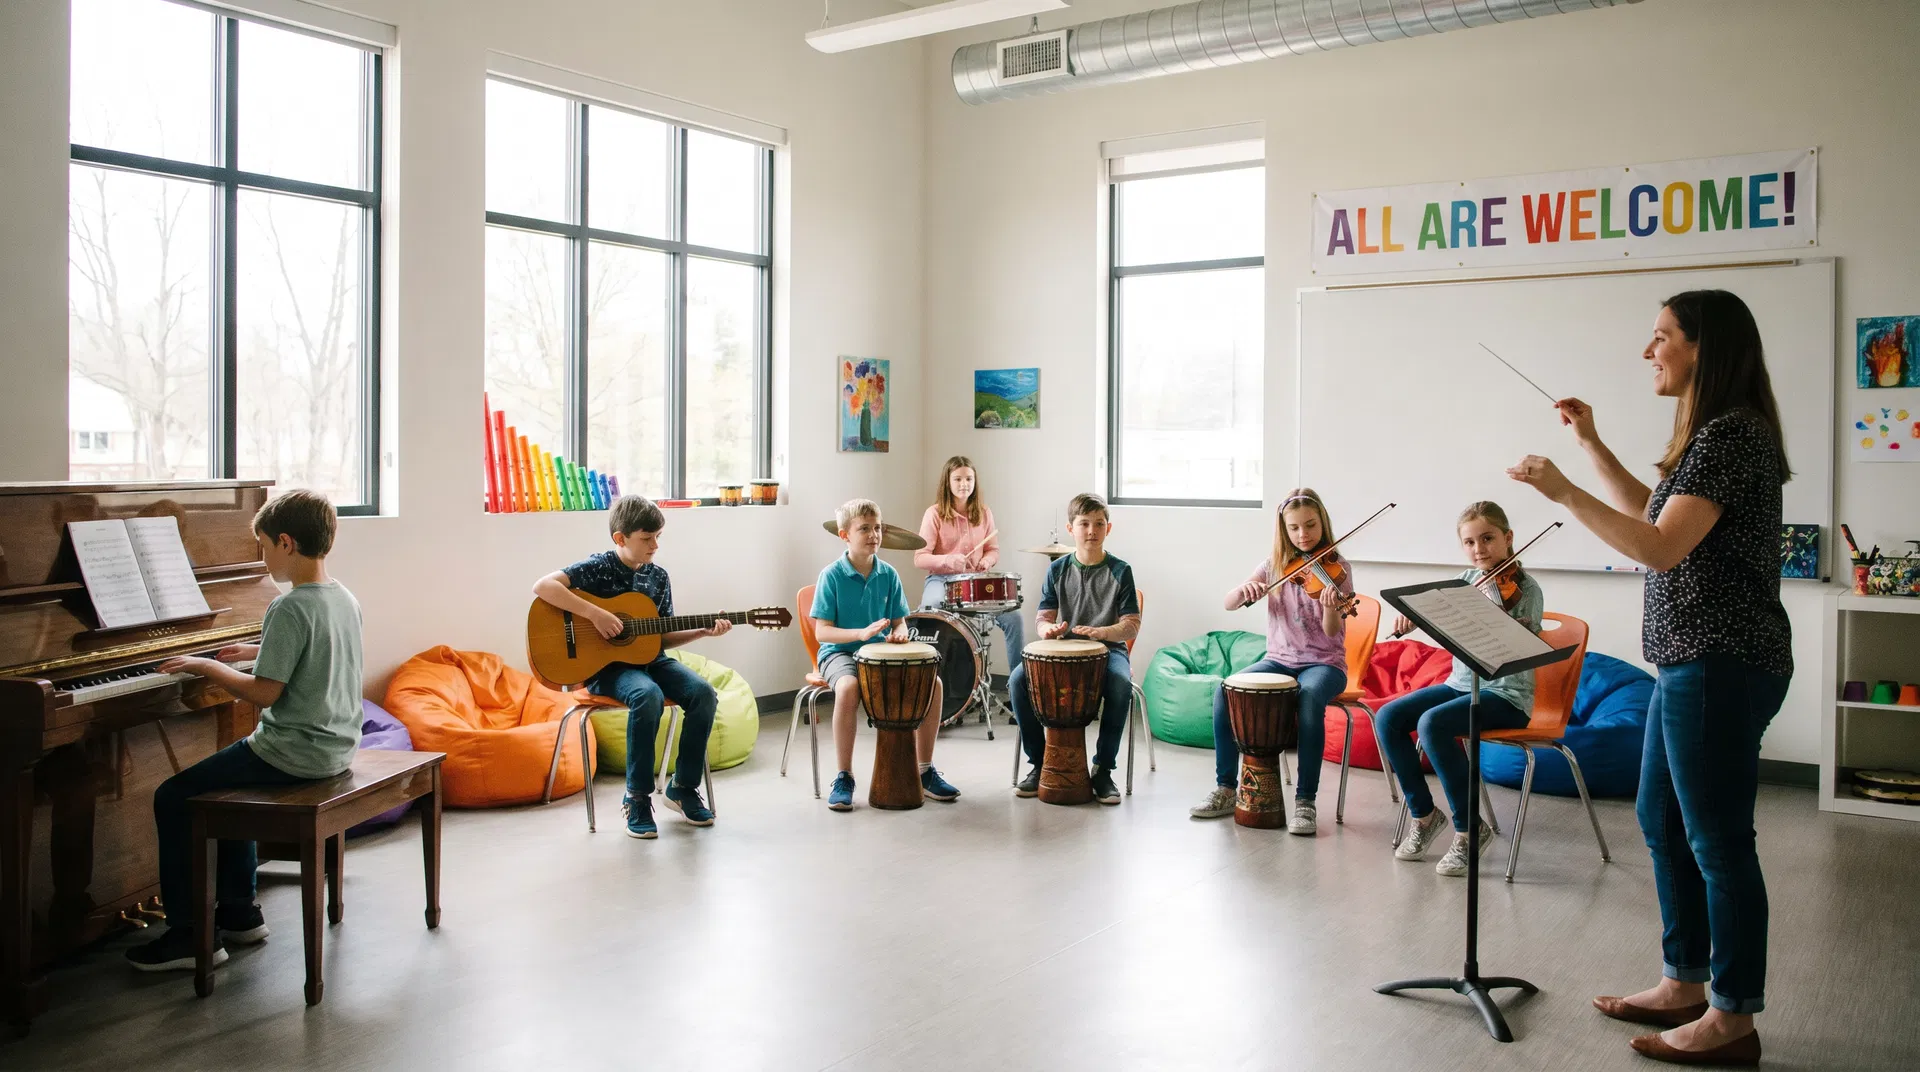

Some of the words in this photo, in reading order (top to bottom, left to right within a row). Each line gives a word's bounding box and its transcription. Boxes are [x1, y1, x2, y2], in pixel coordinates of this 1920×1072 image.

[1327, 206, 1404, 255] ALL
[1417, 197, 1507, 251] ARE
[1522, 172, 1795, 244] WELCOME!
